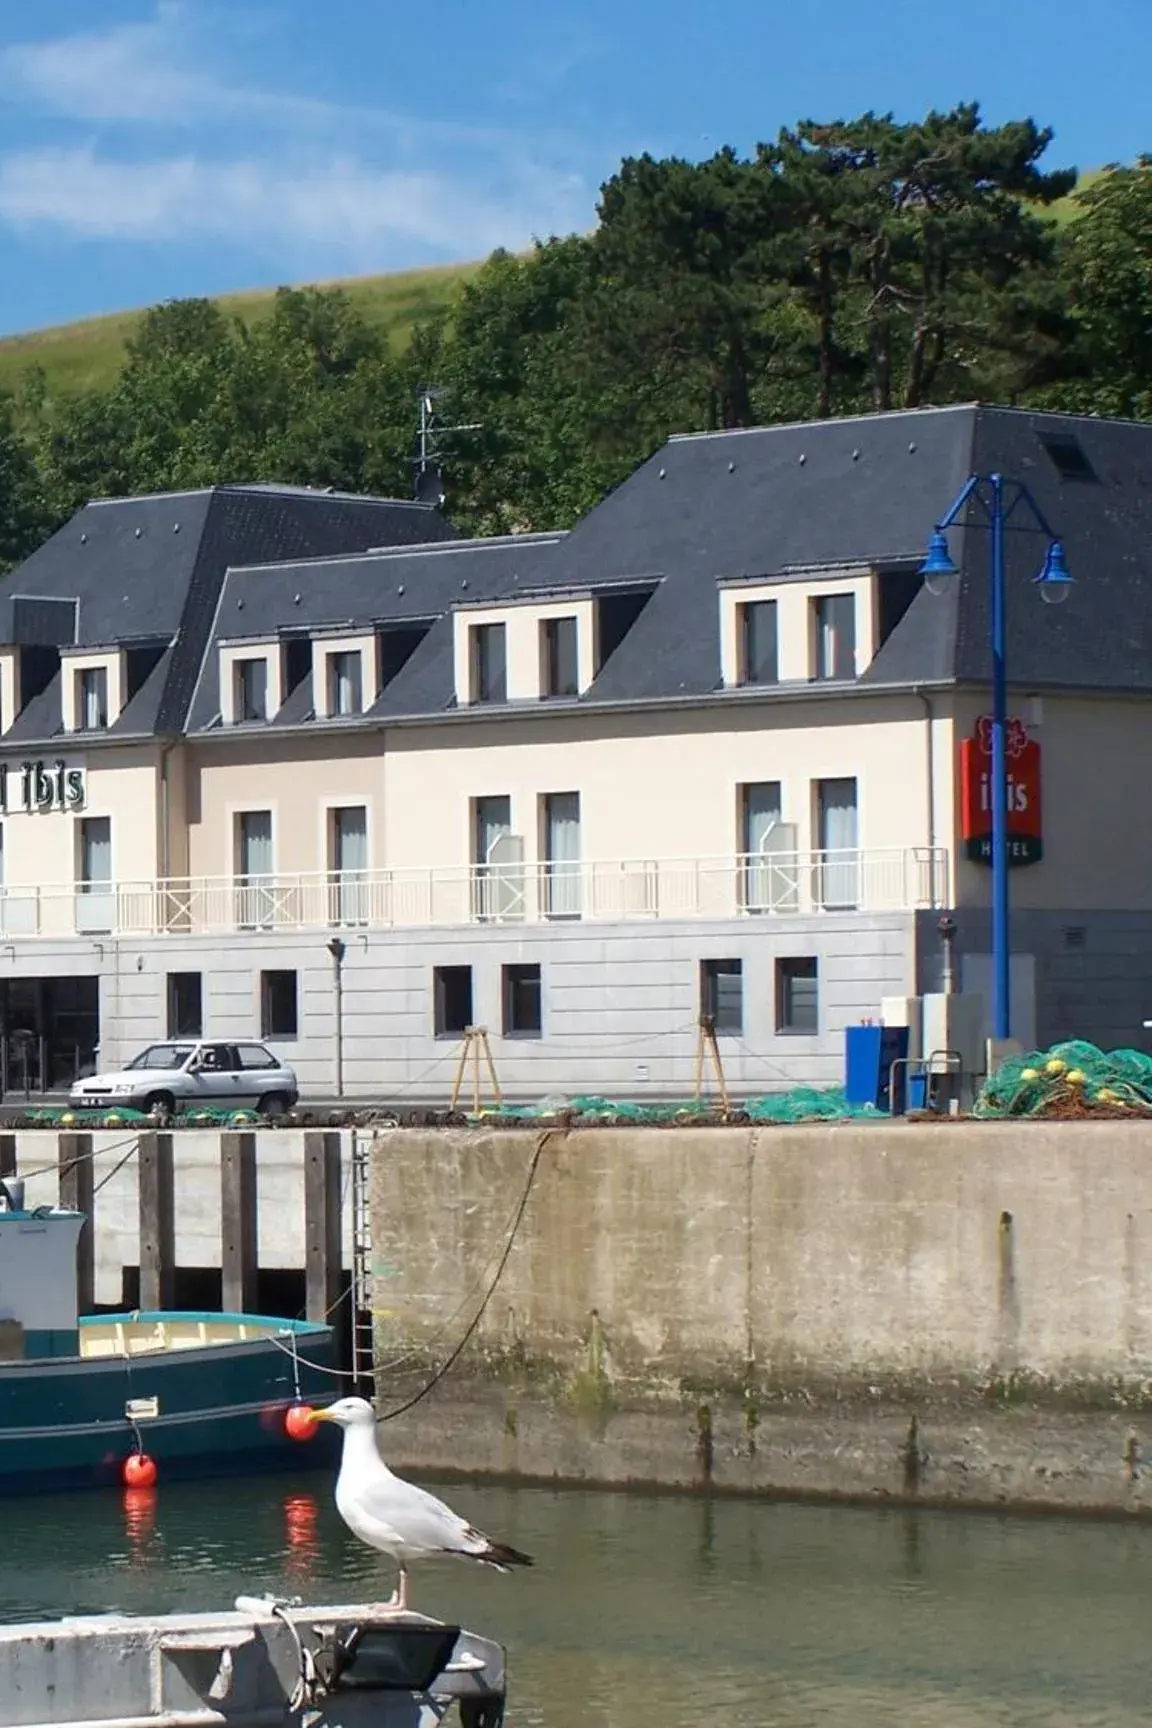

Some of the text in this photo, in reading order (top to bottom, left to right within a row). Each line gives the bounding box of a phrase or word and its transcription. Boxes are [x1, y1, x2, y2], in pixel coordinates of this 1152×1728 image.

[21, 759, 84, 810] ibis
[980, 772, 1028, 812] iis
[981, 842, 1029, 856] HTEL
